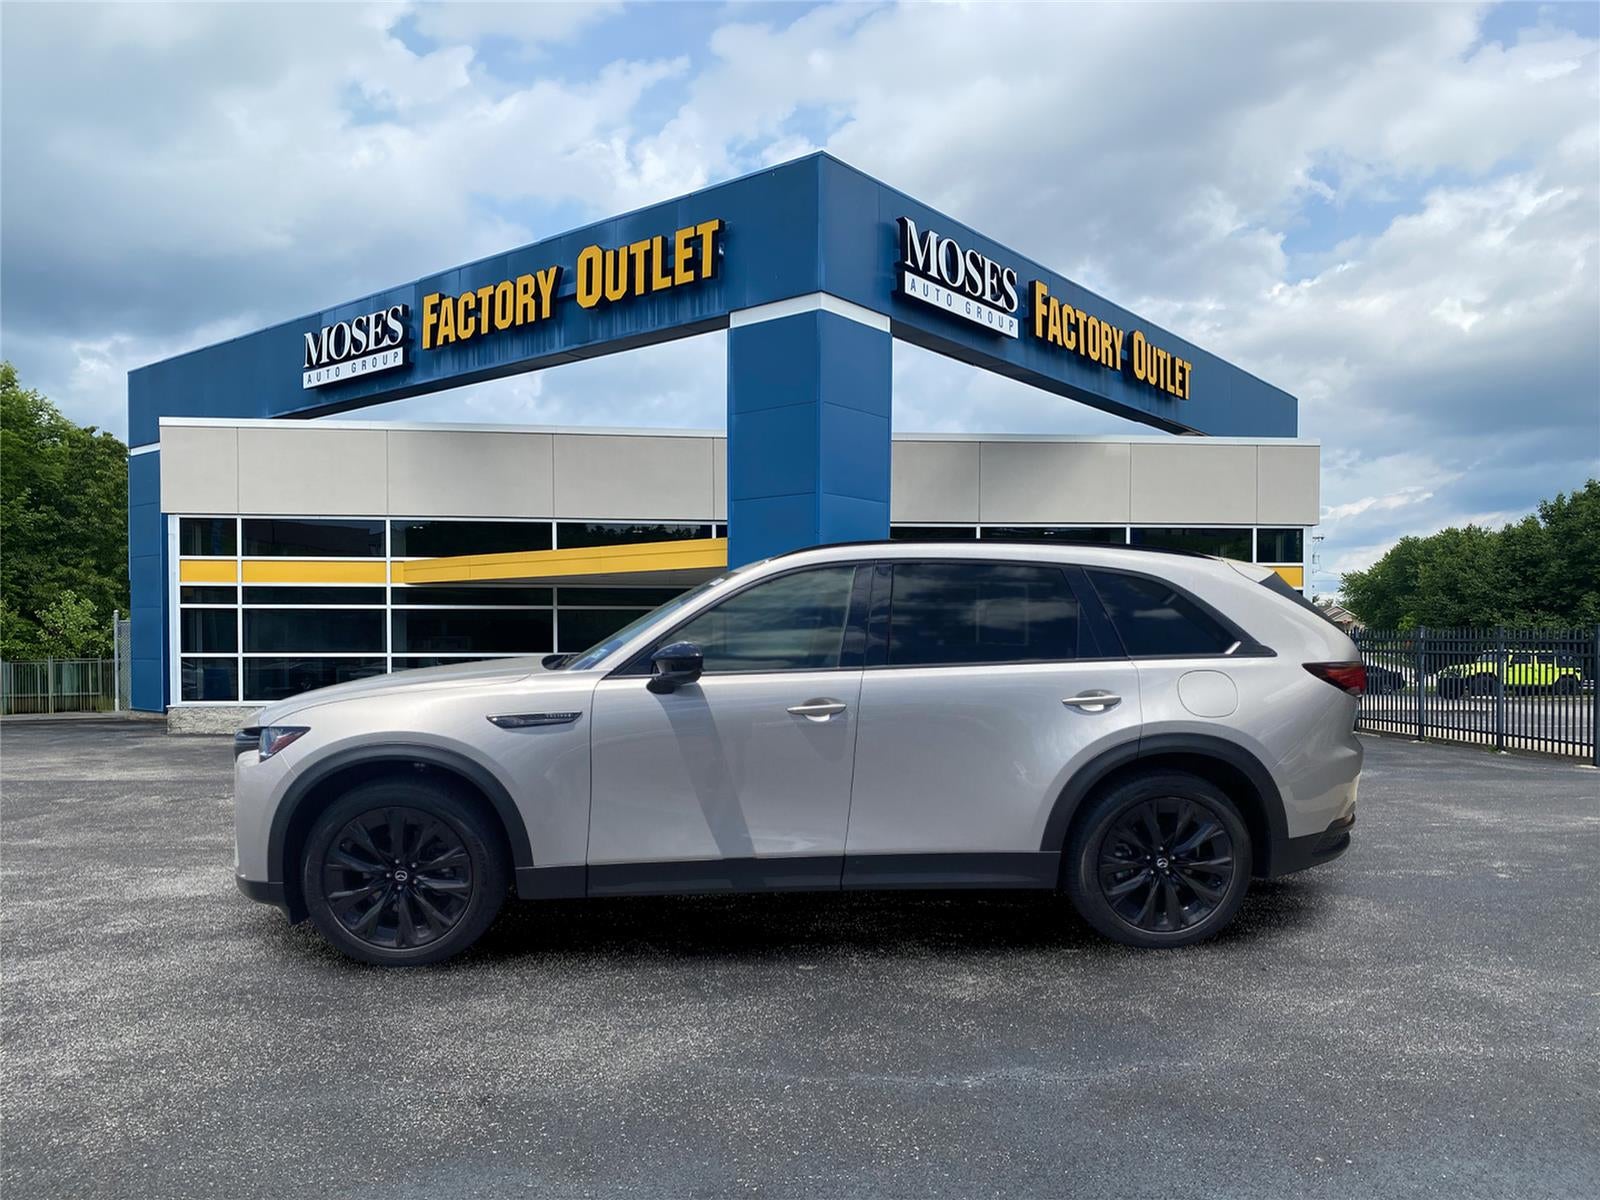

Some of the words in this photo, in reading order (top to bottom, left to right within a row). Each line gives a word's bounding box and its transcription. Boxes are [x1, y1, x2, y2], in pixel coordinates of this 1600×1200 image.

[422, 265, 559, 350] FACTORY
[576, 218, 721, 309] OUTLET
[904, 216, 1019, 313] MOSES
[303, 304, 404, 368] MOSES
[910, 278, 953, 307] AUTO
[965, 302, 1016, 332] GROUP
[1035, 280, 1124, 371] FACTORY
[1133, 330, 1192, 400] OUTLET
[306, 367, 341, 386] AUTO
[351, 352, 400, 374] GROUP
